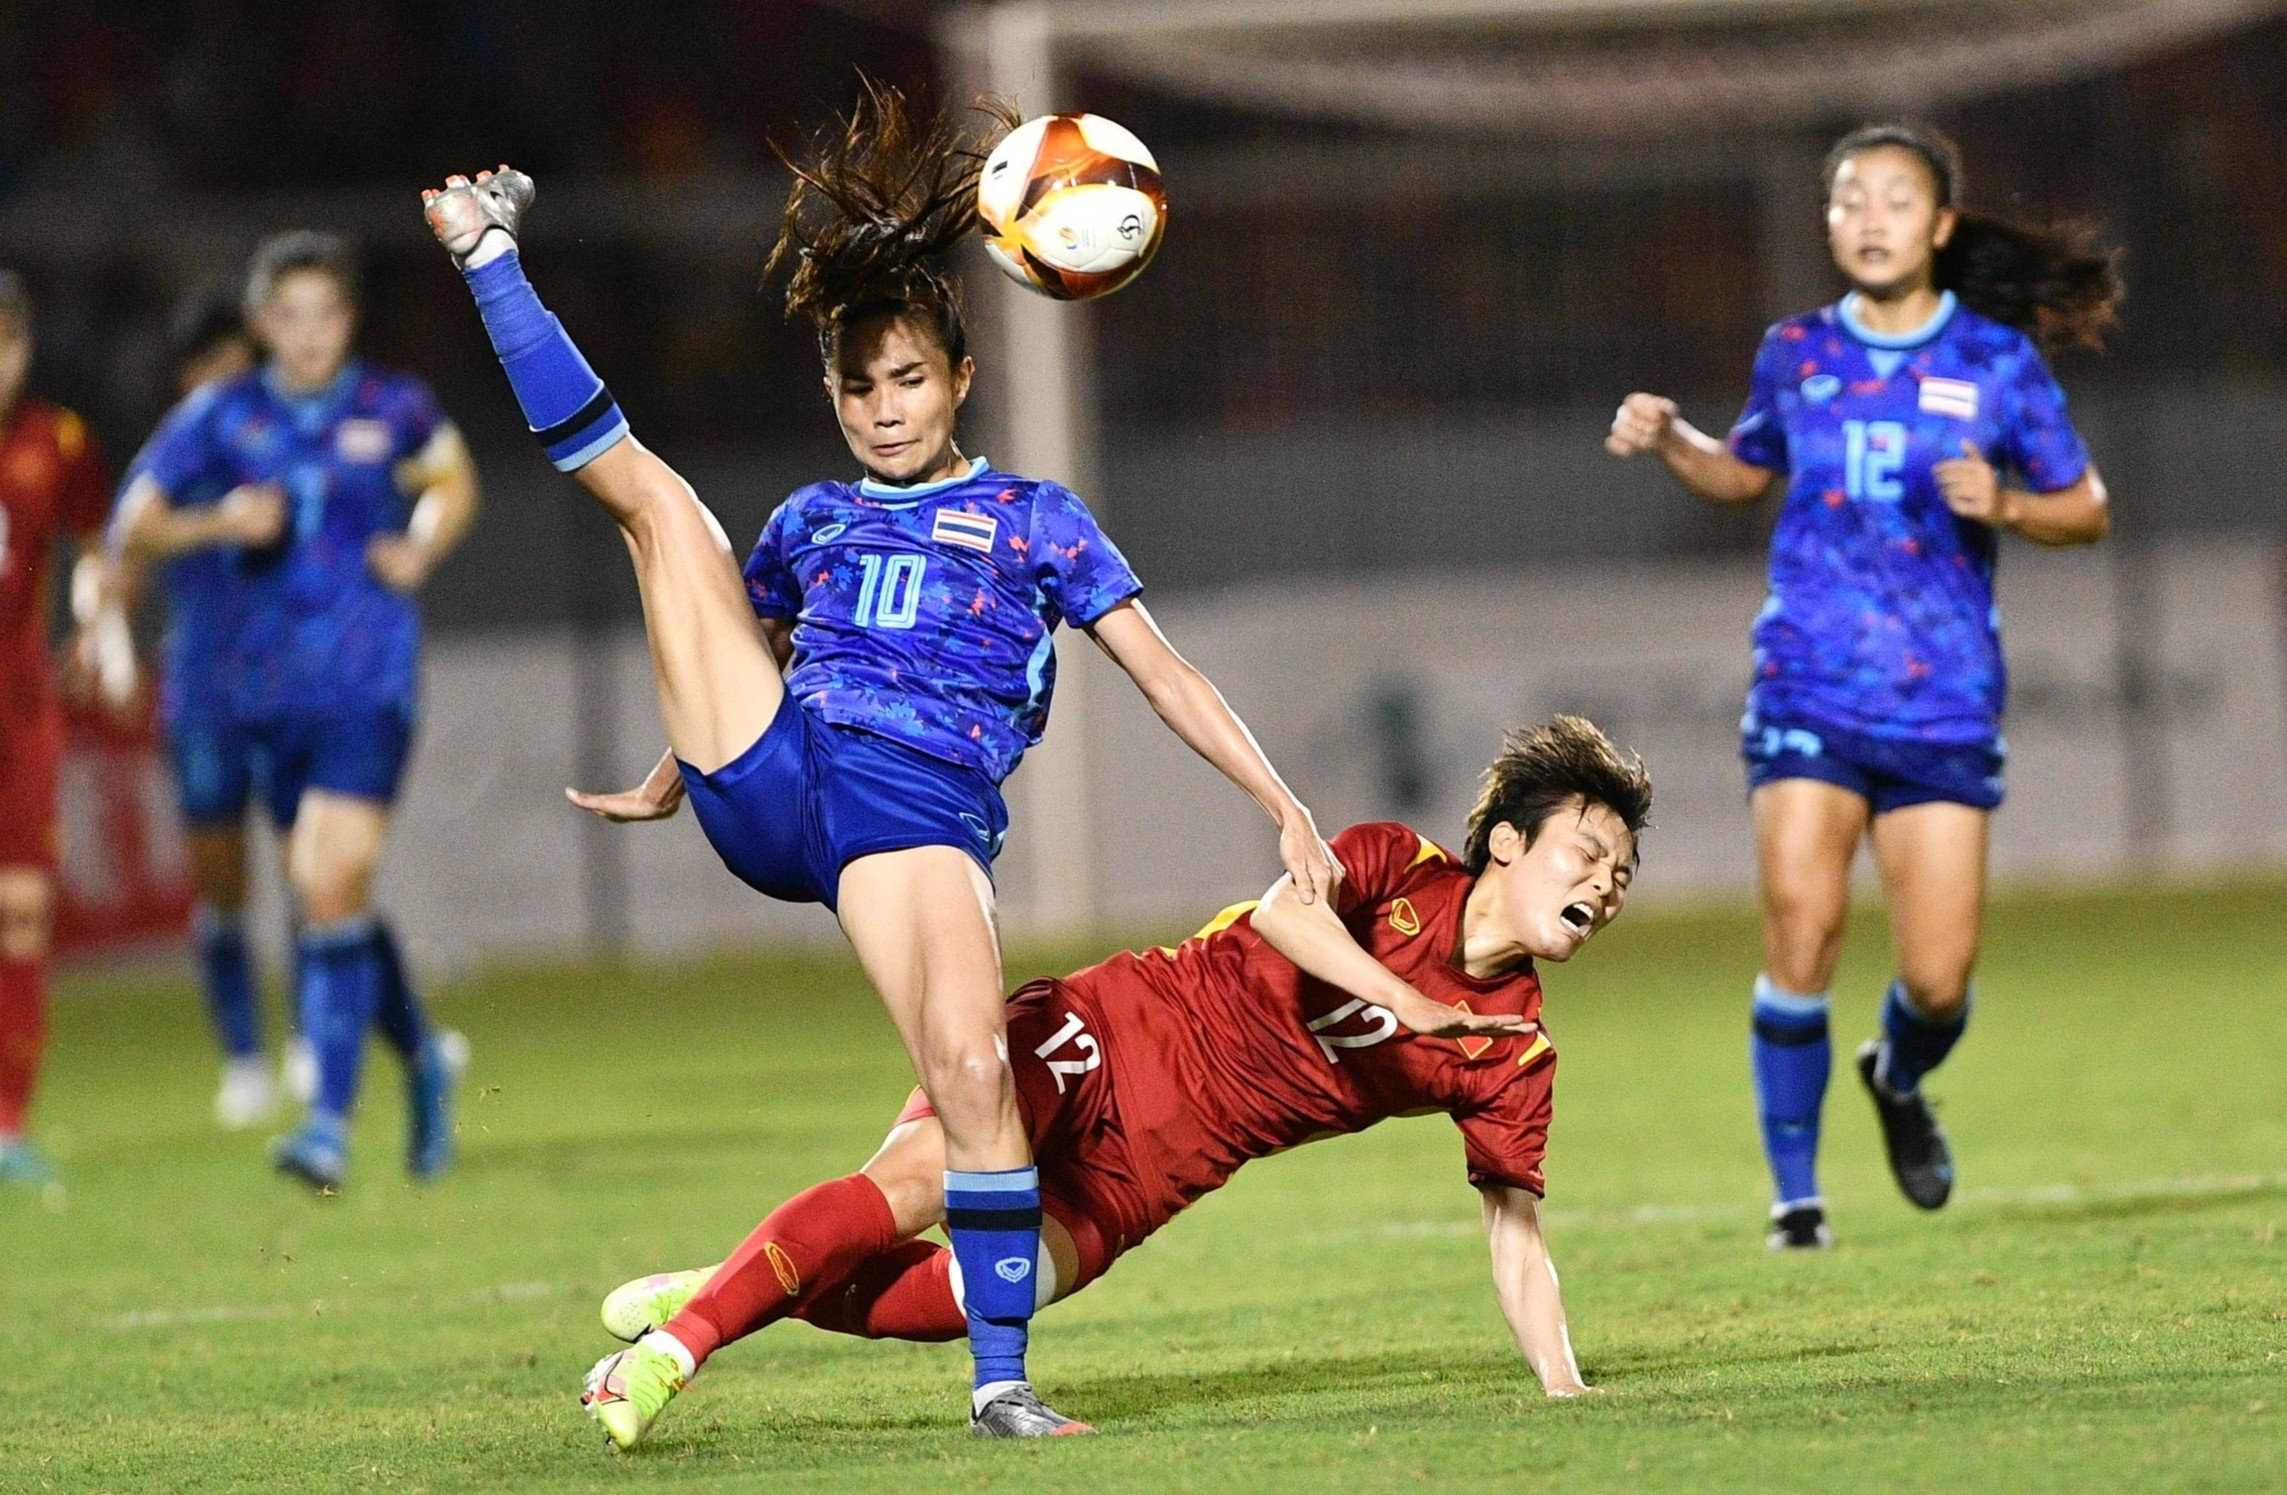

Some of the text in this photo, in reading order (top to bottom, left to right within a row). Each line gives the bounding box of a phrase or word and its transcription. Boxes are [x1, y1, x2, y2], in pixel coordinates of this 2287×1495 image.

[1841, 420, 1907, 502] 12
[854, 554, 927, 629] 10
[1034, 1011, 1101, 1095] 12
[1306, 998, 1398, 1064] 12
